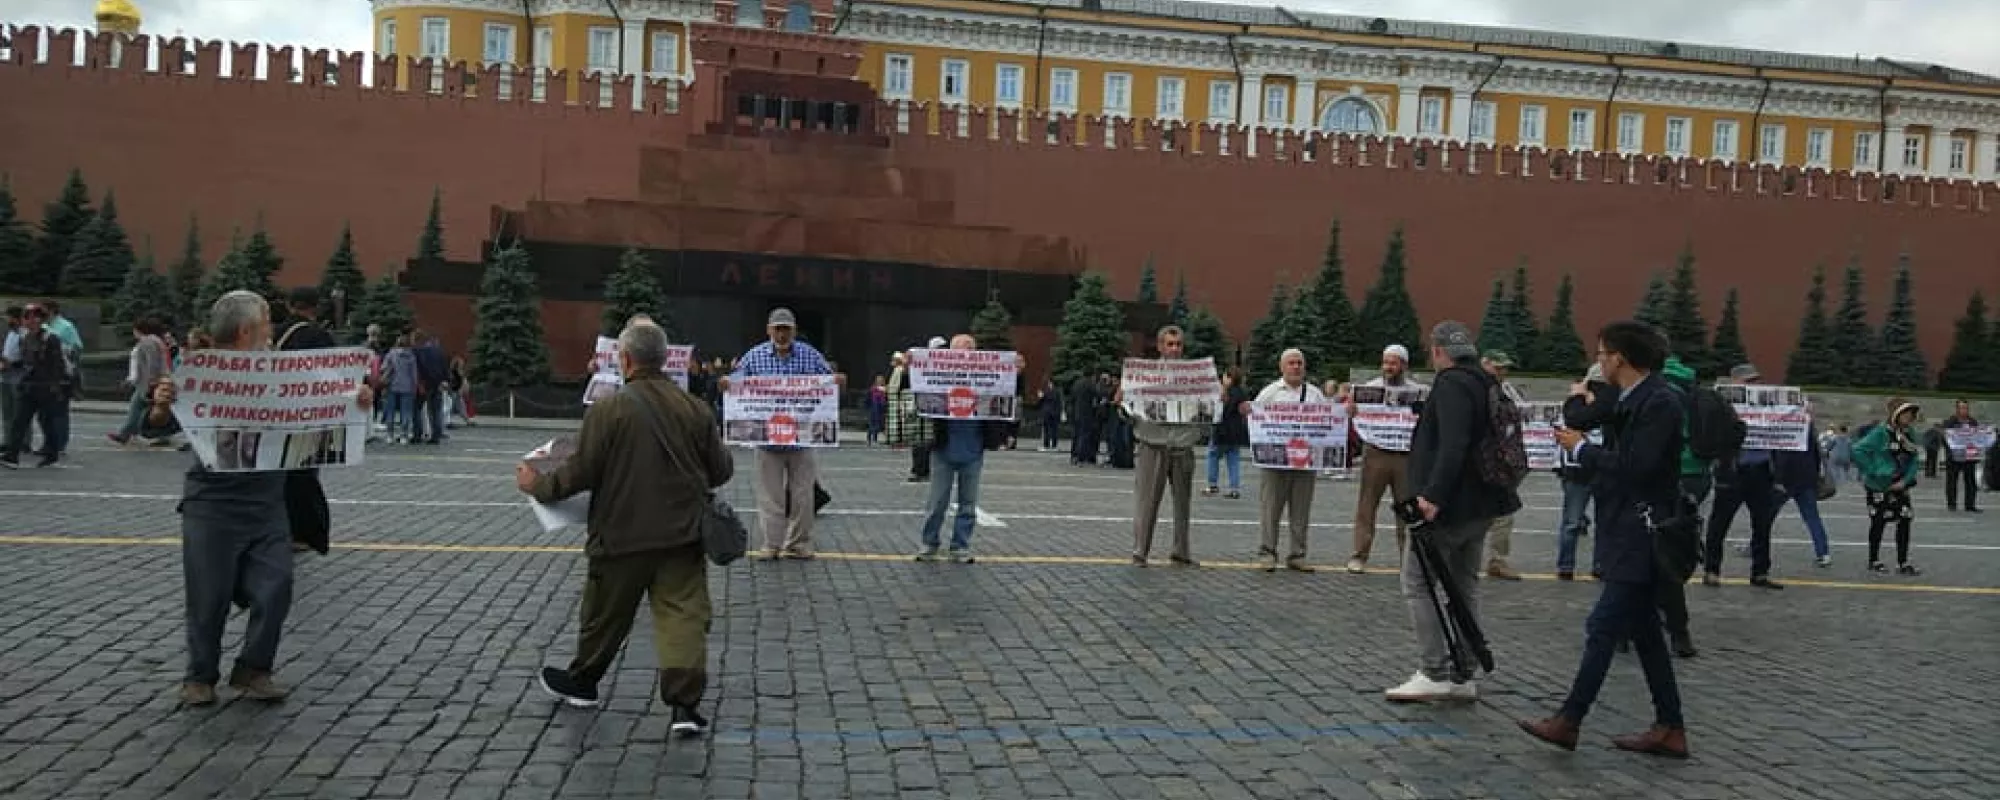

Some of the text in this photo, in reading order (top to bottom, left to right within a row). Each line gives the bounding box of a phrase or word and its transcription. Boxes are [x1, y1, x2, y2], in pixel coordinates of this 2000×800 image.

[256, 356, 268, 372] С
[201, 380, 268, 398] КРЫМУ
[277, 383, 309, 398] ЭТО
[194, 403, 347, 422] С ИНАКОМЫСЛИЕМ
